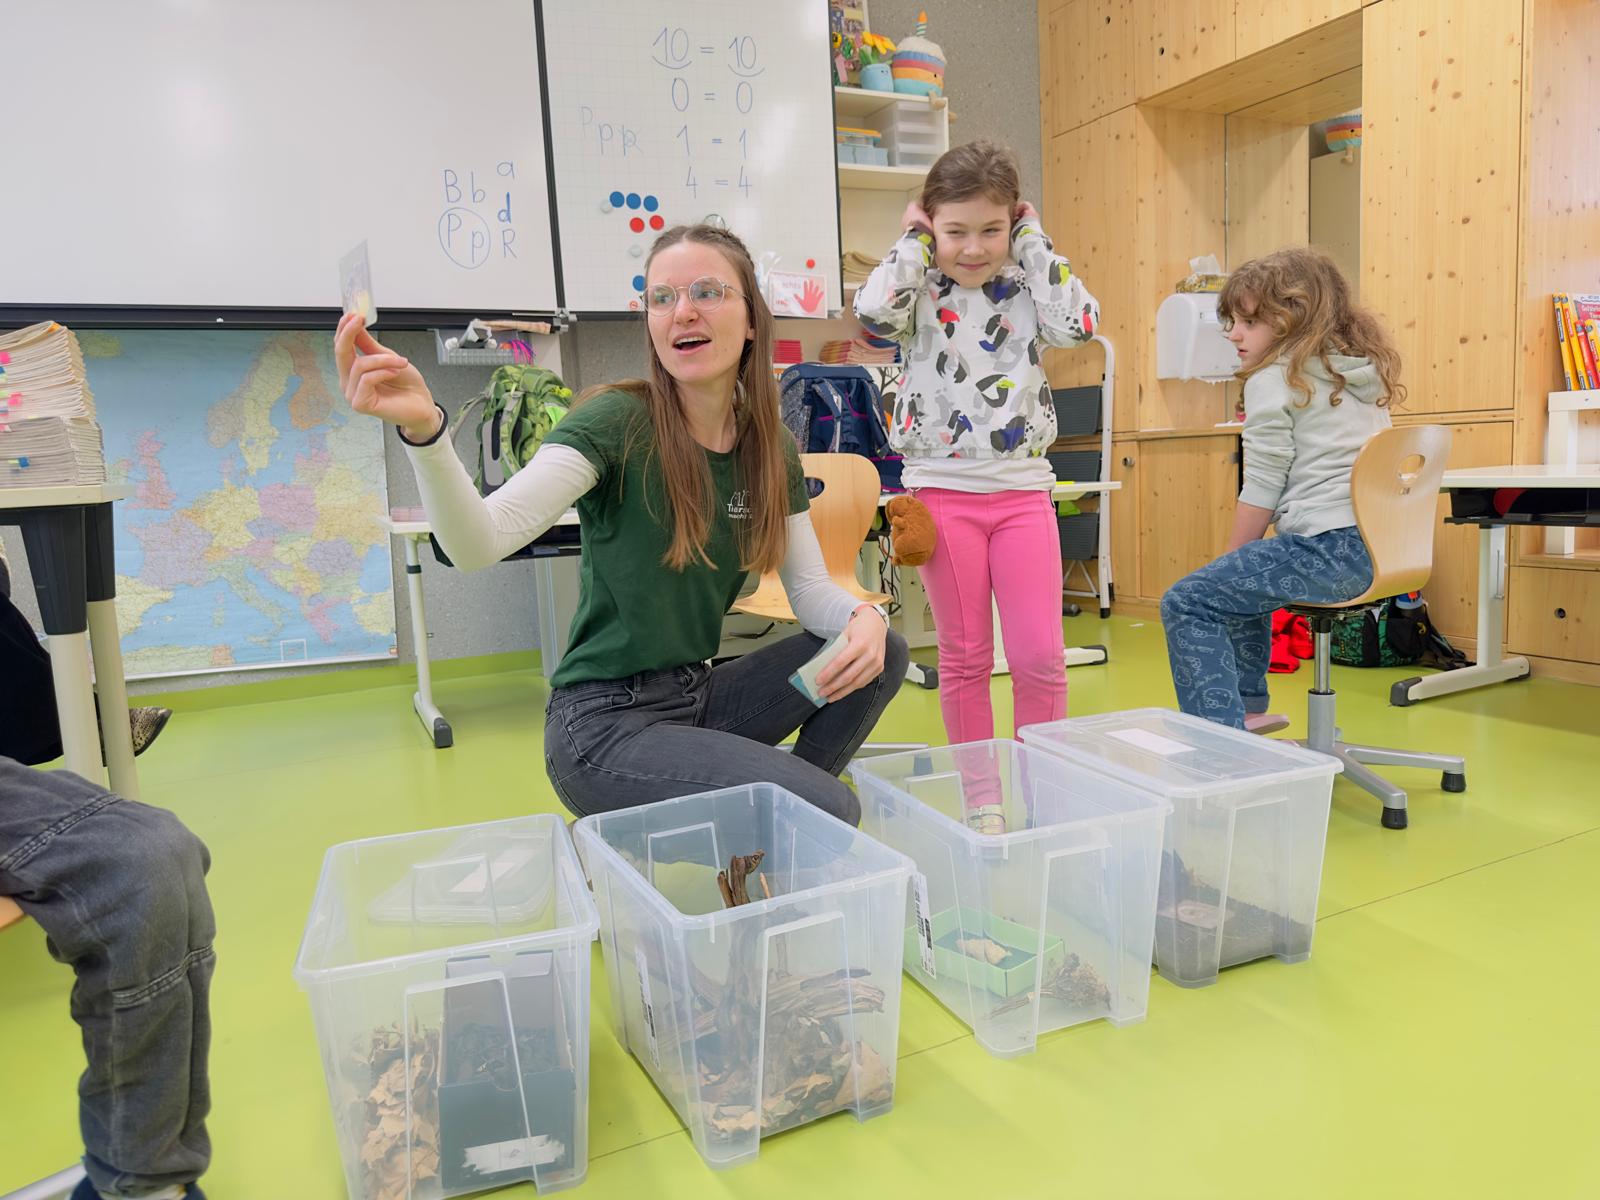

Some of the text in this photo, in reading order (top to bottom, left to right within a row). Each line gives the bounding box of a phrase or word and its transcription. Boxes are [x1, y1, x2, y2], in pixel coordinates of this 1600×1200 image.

[652, 27, 689, 64] 10
[728, 35, 757, 69] 10
[676, 124, 690, 156] 1
[739, 128, 747, 160] 1
[686, 166, 699, 199] 4
[739, 165, 752, 199] 4
[497, 191, 512, 224] d
[502, 228, 518, 259] R
